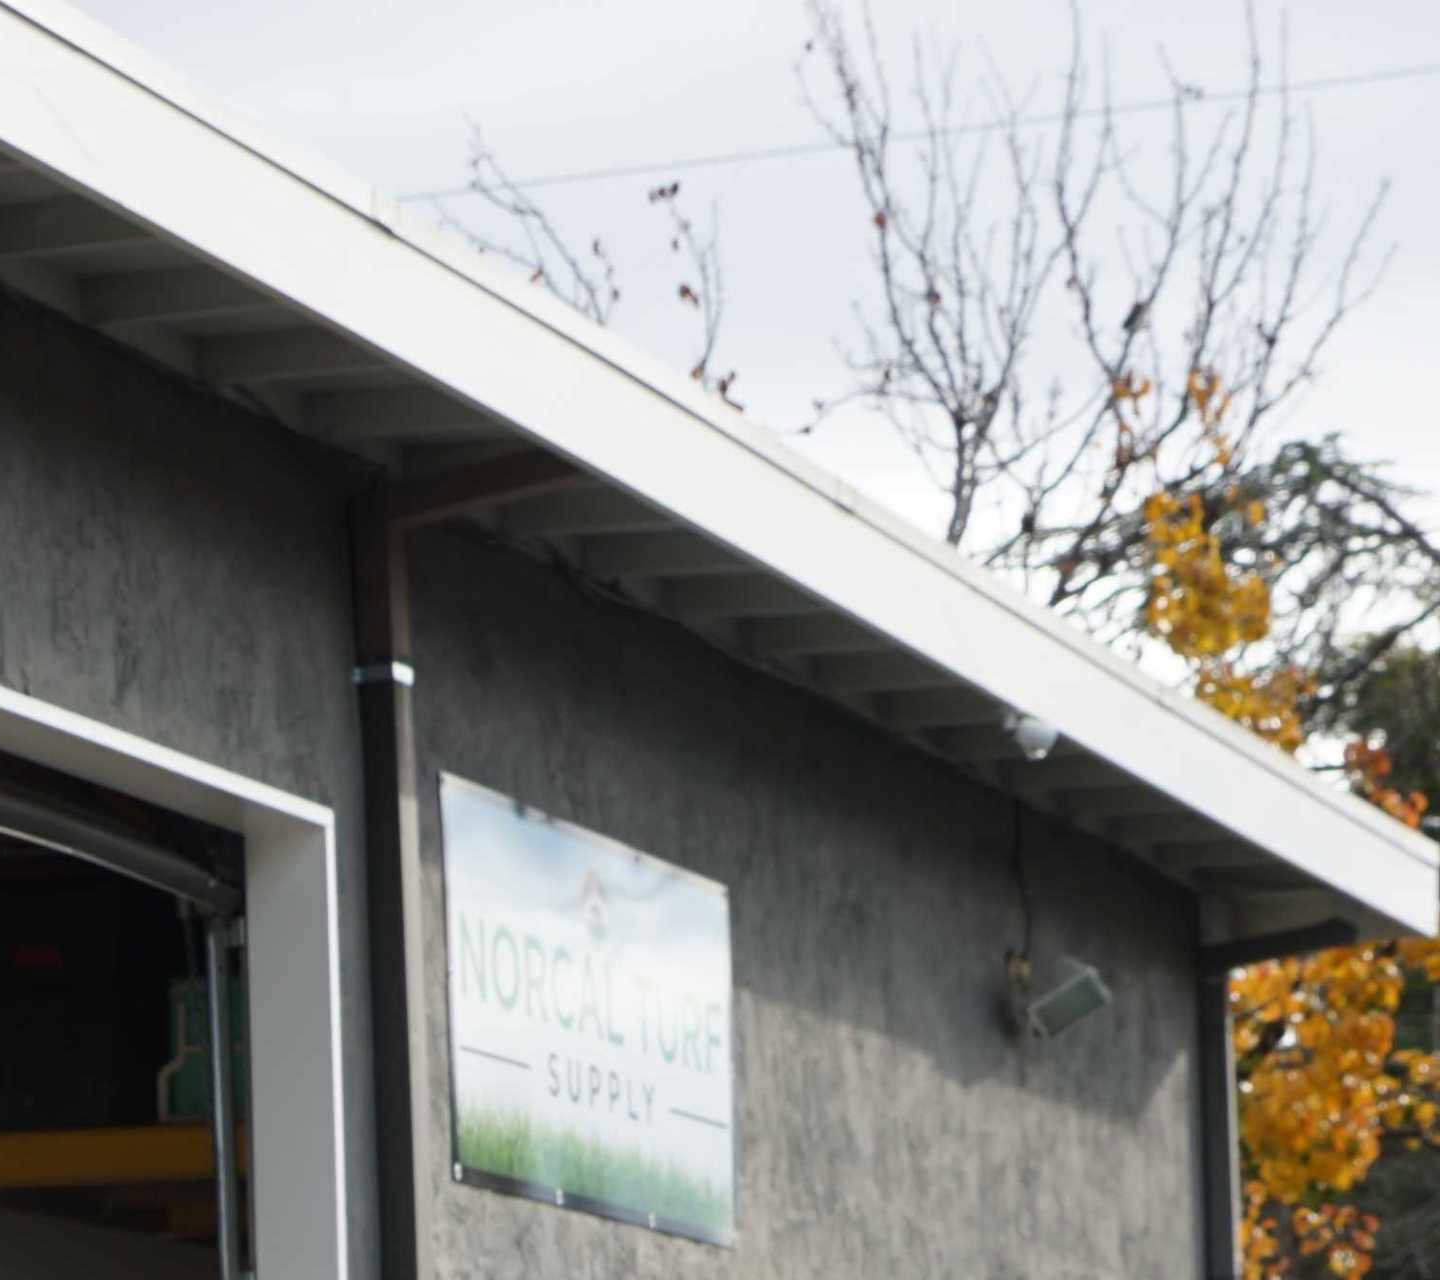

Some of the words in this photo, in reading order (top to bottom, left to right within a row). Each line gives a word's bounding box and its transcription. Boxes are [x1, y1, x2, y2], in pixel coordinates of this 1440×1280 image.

[457, 910, 624, 1047] NORCAL
[633, 974, 721, 1074] TURF
[548, 1053, 655, 1122] SUPPLY
